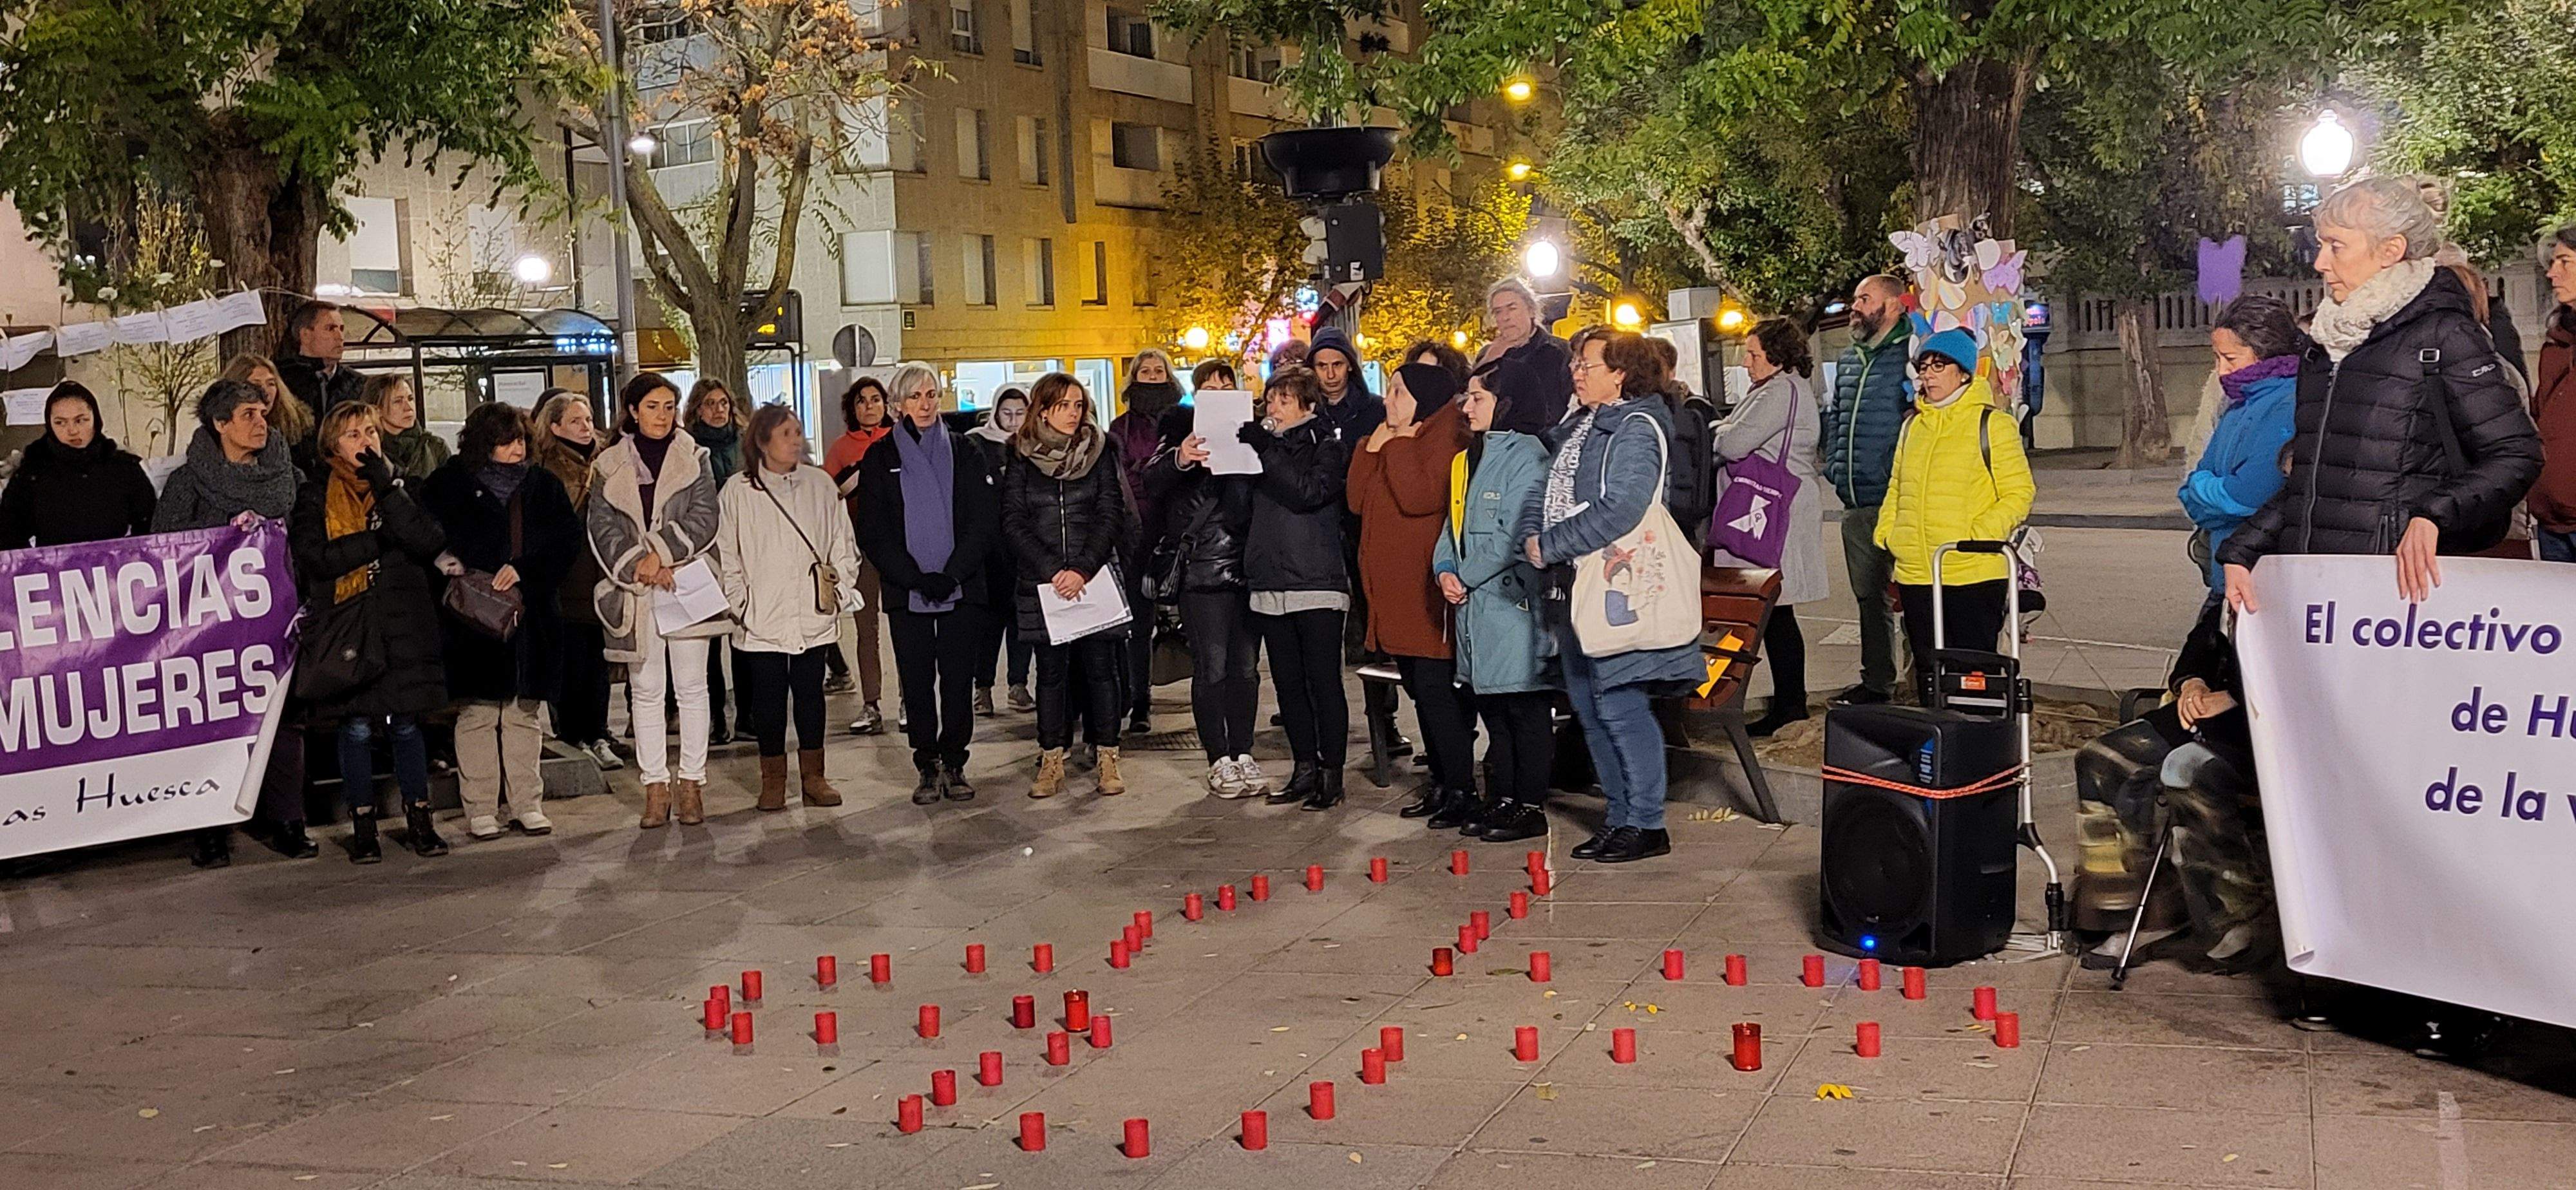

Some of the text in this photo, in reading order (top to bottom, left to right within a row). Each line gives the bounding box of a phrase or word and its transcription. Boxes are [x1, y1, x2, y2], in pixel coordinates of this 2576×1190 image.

[2306, 601, 2561, 654] El colectivo
[0, 645, 278, 753] MUJERES
[2451, 687, 2508, 734] de
[76, 773, 220, 813] Huesca
[2425, 767, 2483, 815] de
[2501, 771, 2547, 821] la
